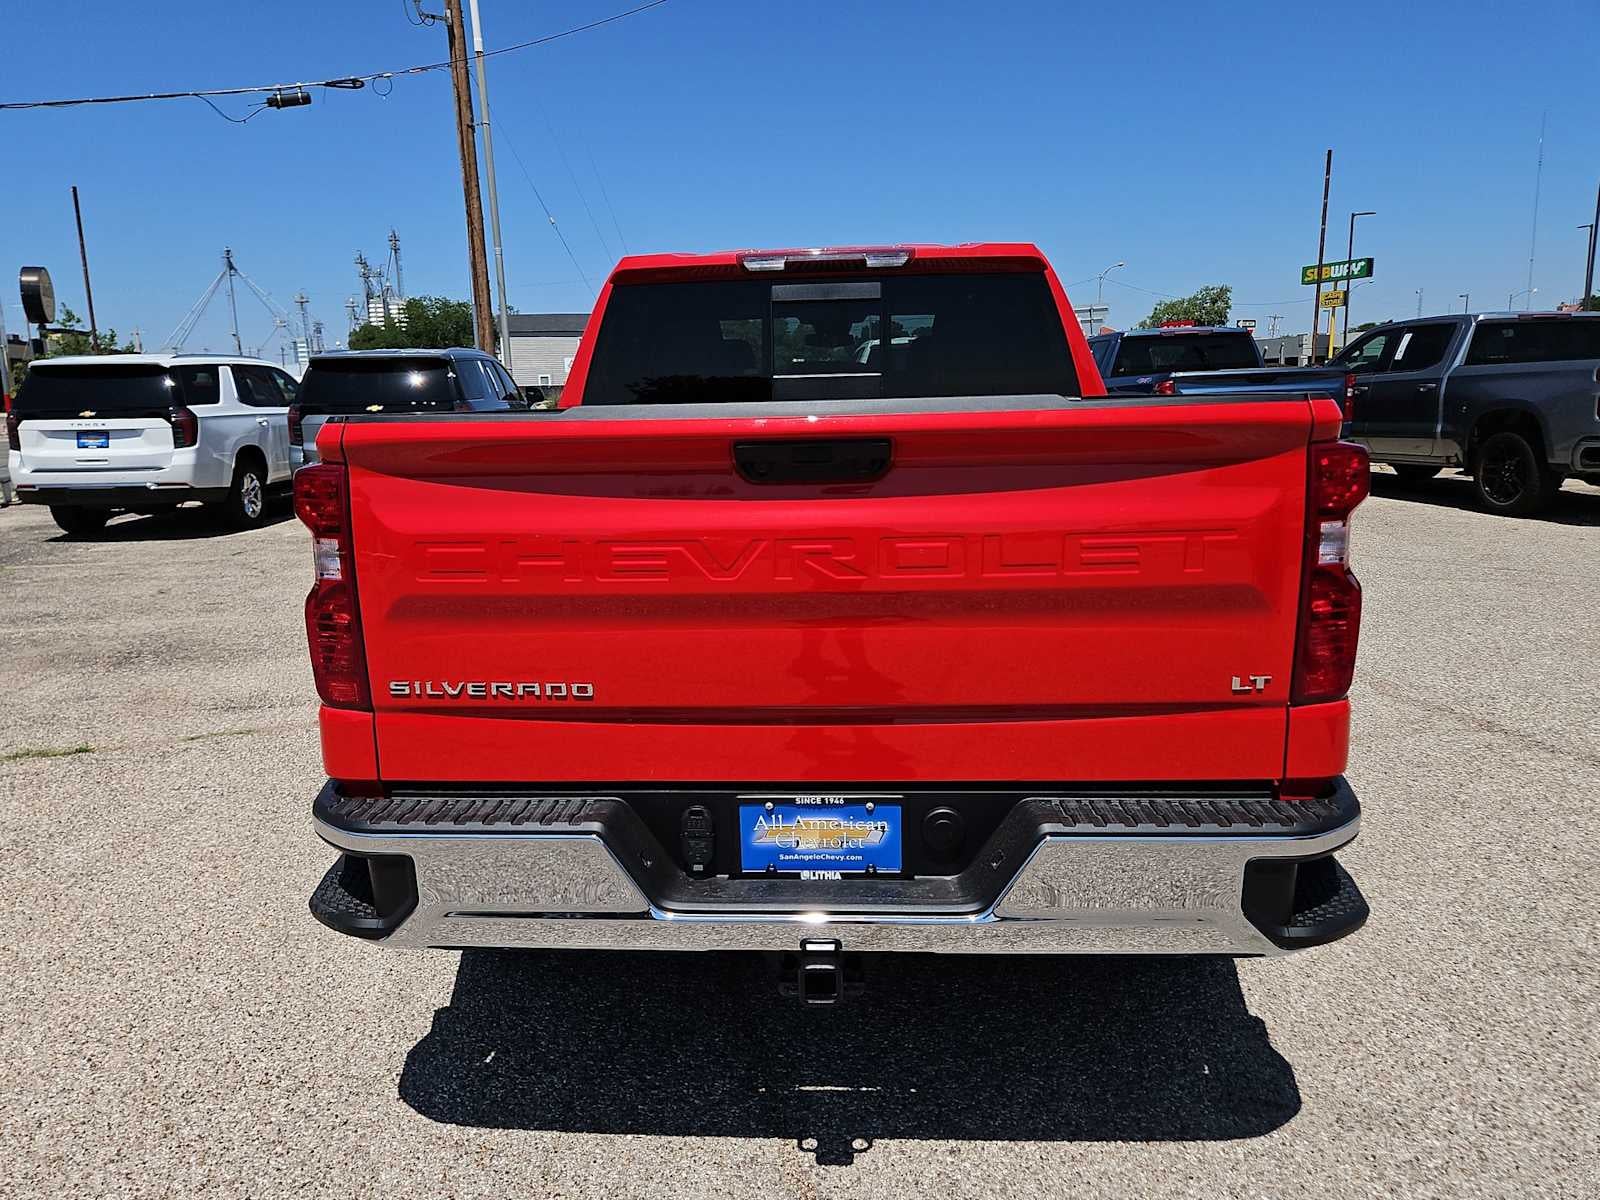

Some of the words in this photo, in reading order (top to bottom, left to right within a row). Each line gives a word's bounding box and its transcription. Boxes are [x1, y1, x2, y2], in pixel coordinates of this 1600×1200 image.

[415, 532, 1239, 583] CHEVROLET
[389, 680, 594, 698] SILVERADO
[1232, 675, 1272, 690] LT
[754, 814, 783, 831] All
[792, 815, 889, 831] American
[775, 831, 865, 849] Chevrolet
[779, 853, 863, 862] SanAngeloChevy.com
[810, 871, 842, 880] LITHIA
